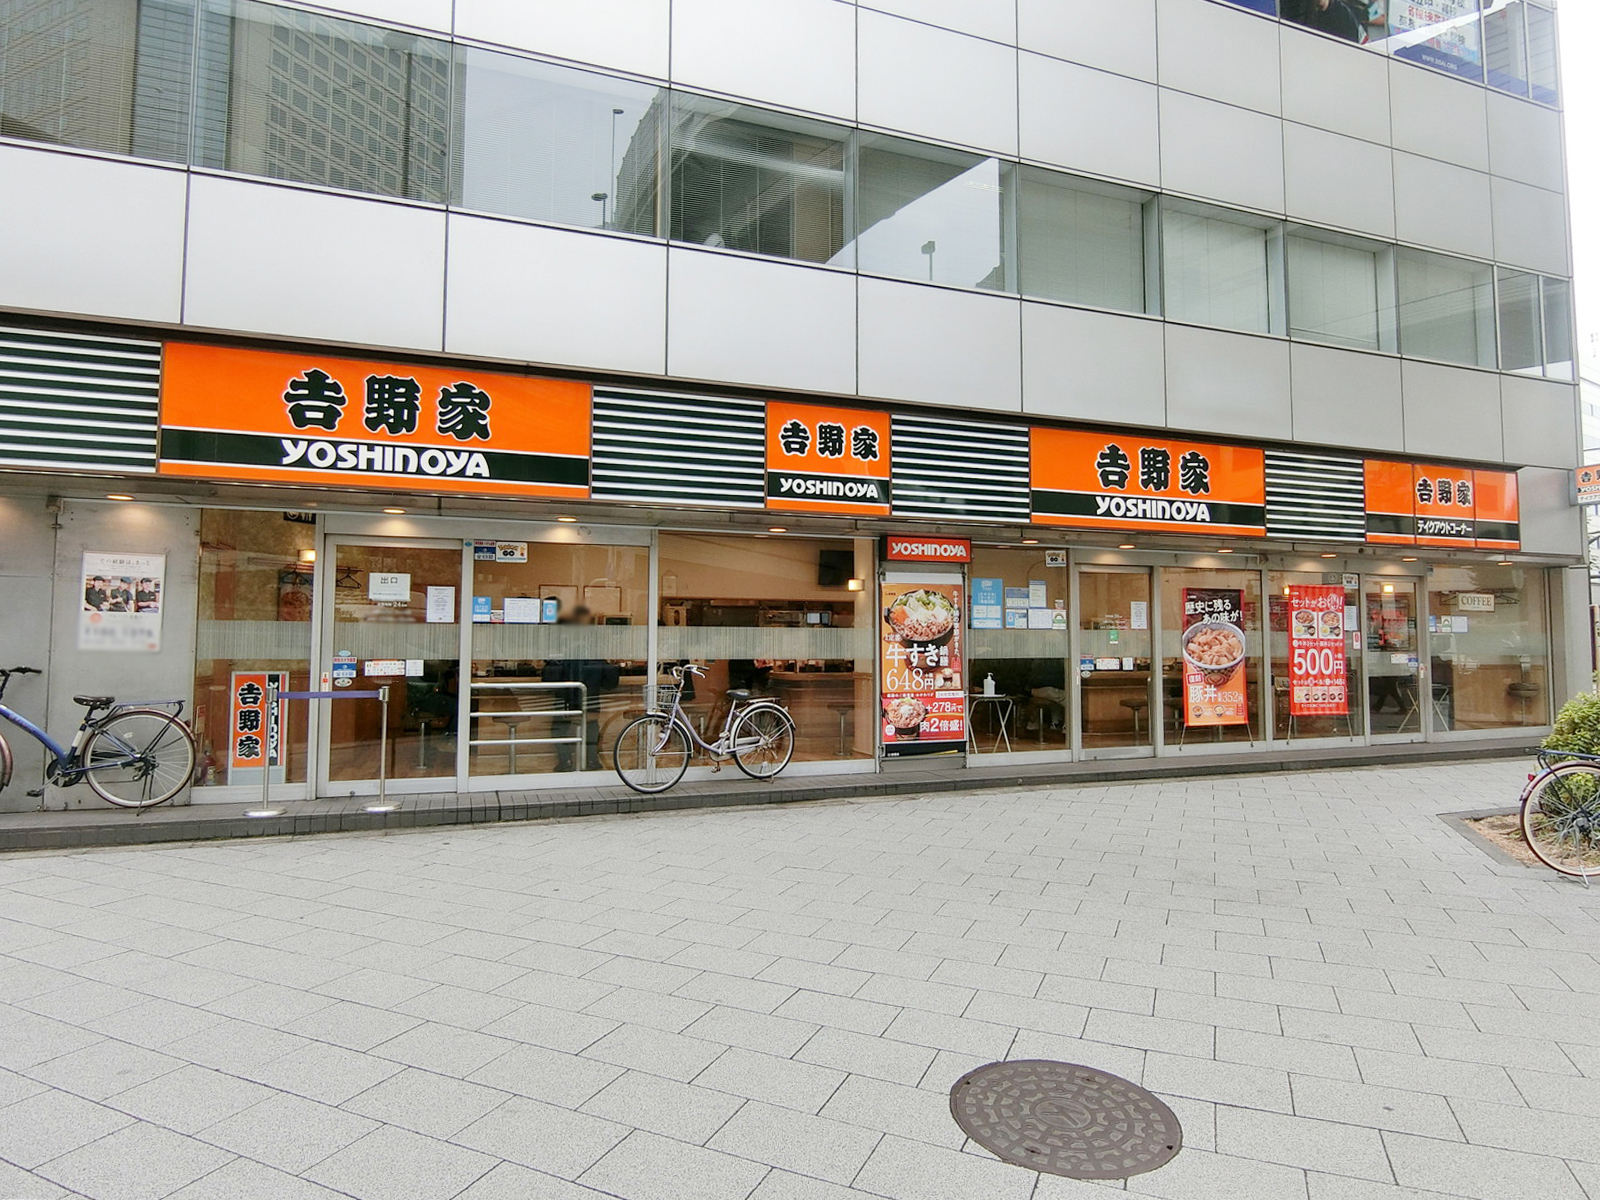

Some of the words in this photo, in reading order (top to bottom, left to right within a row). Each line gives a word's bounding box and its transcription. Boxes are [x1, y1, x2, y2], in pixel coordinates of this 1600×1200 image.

[283, 367, 492, 442] 吉野家
[778, 418, 880, 462] 吉野家
[281, 438, 491, 478] YOSHINOYA
[1095, 442, 1211, 496] 吉野家
[779, 477, 879, 499] YOSHINOYA
[1095, 495, 1211, 522] YOSHINOYA
[1417, 519, 1473, 536] テイクアウトコーナー
[891, 542, 967, 557] YOSHINOYA
[380, 576, 398, 584] 出口
[1184, 598, 1232, 616] 歴史に残る
[1461, 595, 1492, 607] COFFEE
[1202, 609, 1244, 625] あの味が!
[268, 681, 279, 758] YHINOYA
